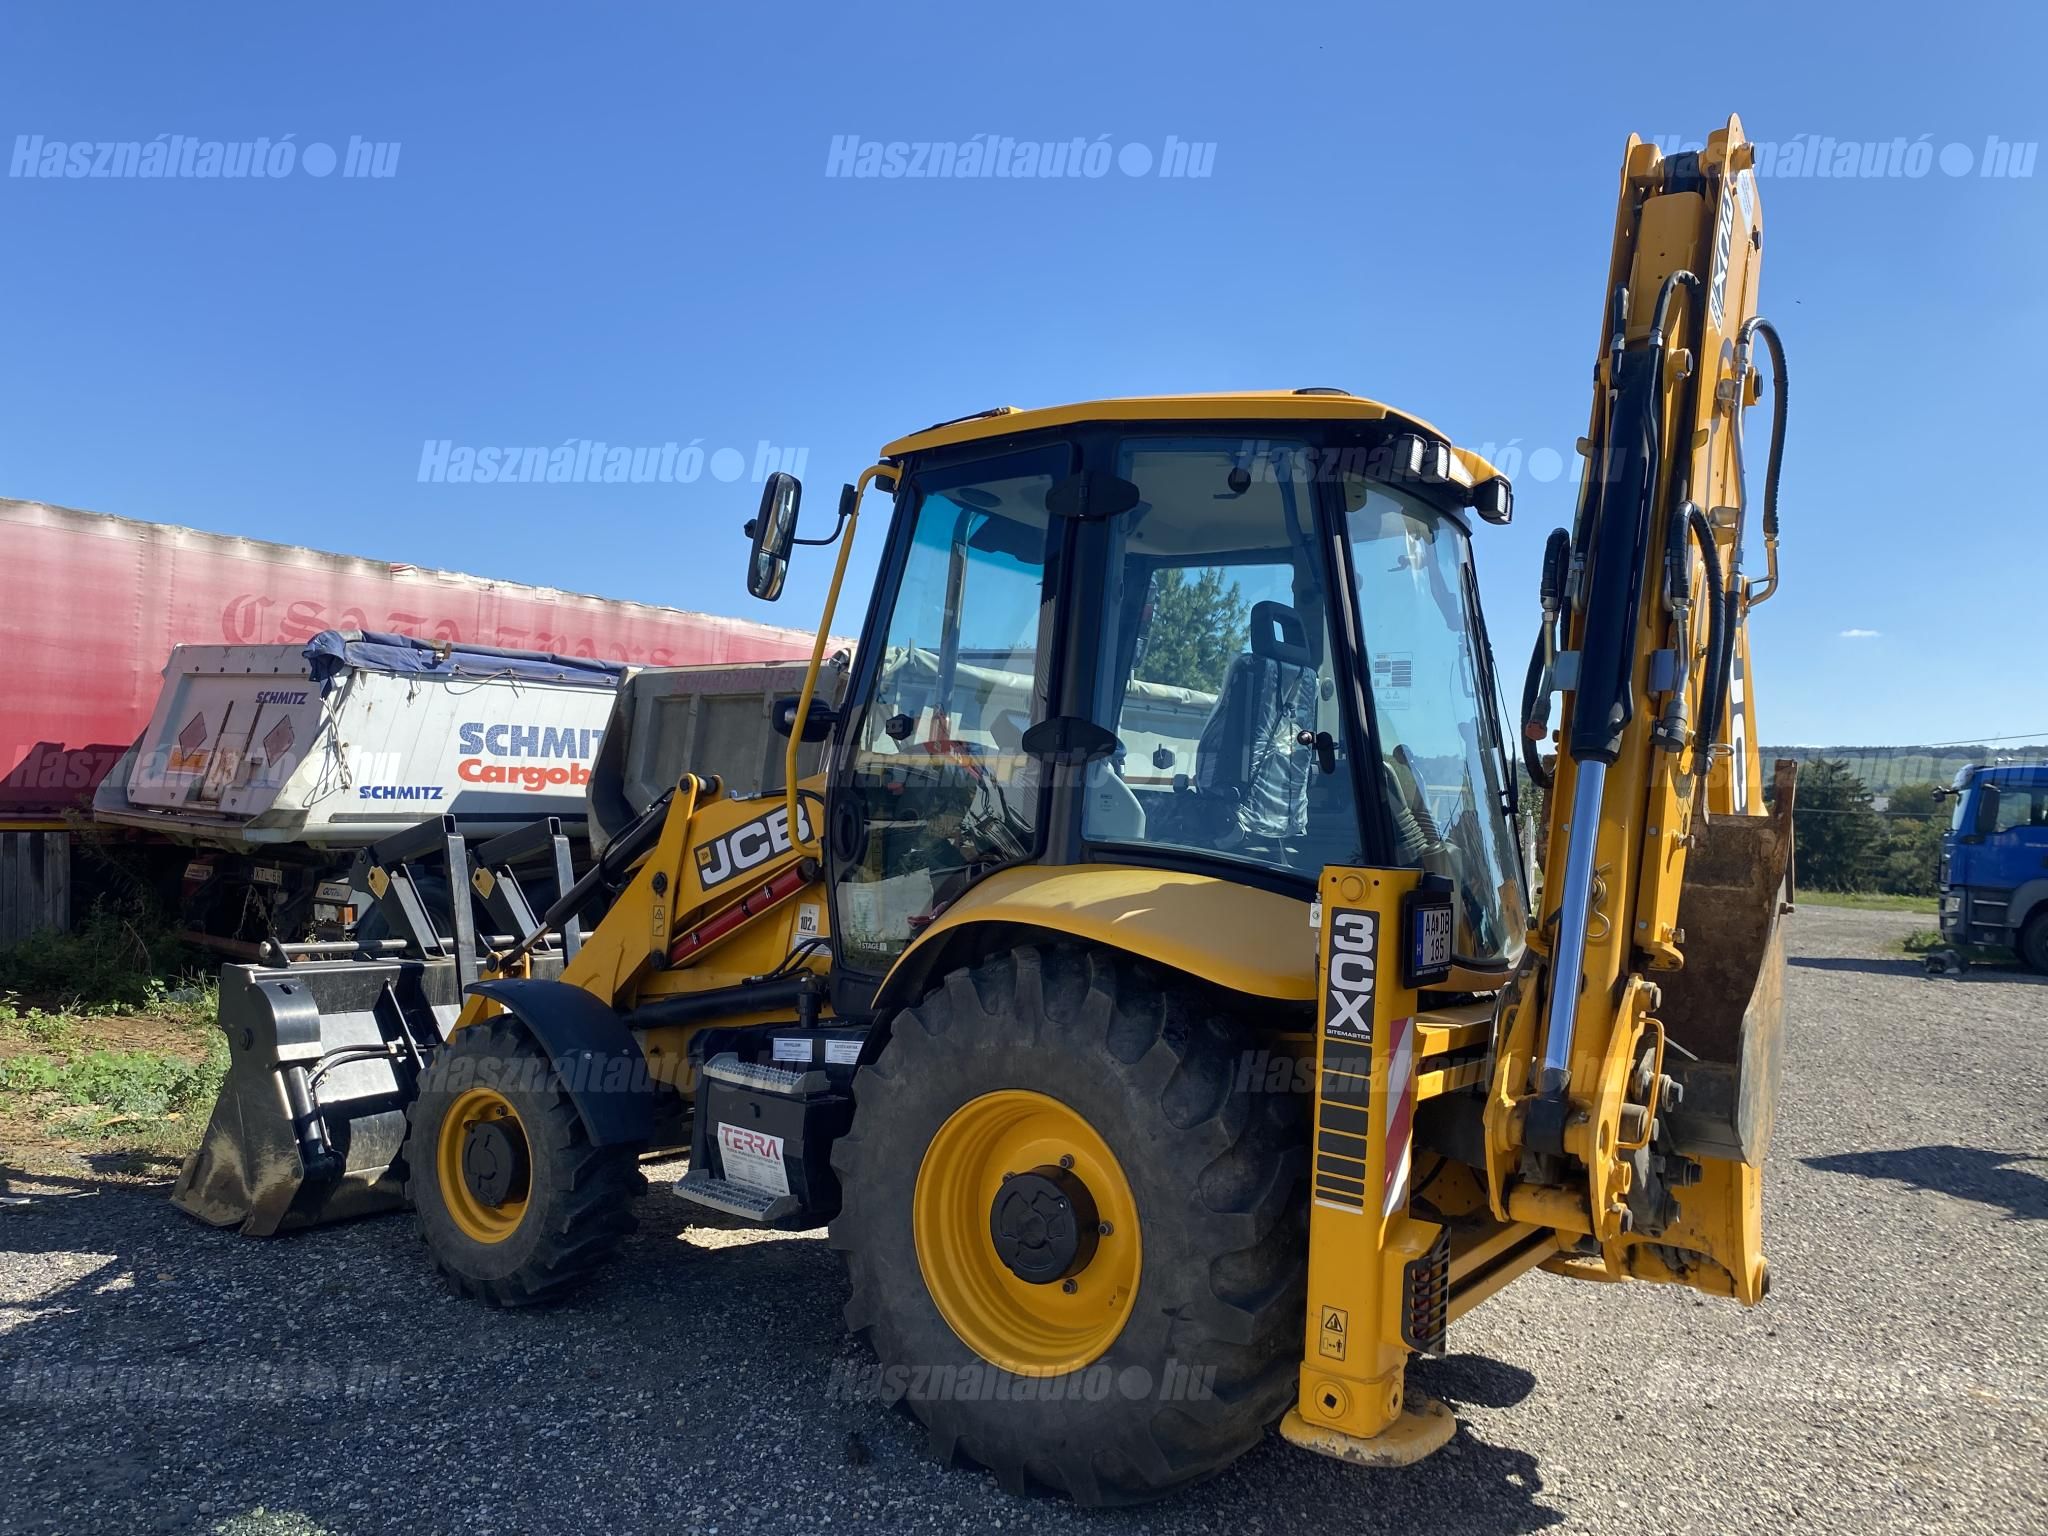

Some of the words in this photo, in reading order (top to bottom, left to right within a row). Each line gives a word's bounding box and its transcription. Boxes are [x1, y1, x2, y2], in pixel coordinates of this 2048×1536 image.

[256, 691, 308, 705] SCHMITZ
[359, 785, 443, 800] SCHMITZ
[702, 804, 809, 884] JCB
[800, 916, 813, 930] 102
[862, 942, 880, 950] STAGE
[1430, 938, 1444, 961] 185
[1327, 913, 1374, 1031] 3CX
[1326, 1028, 1371, 1041] SITEMASTER
[721, 1126, 781, 1160] TERRA
